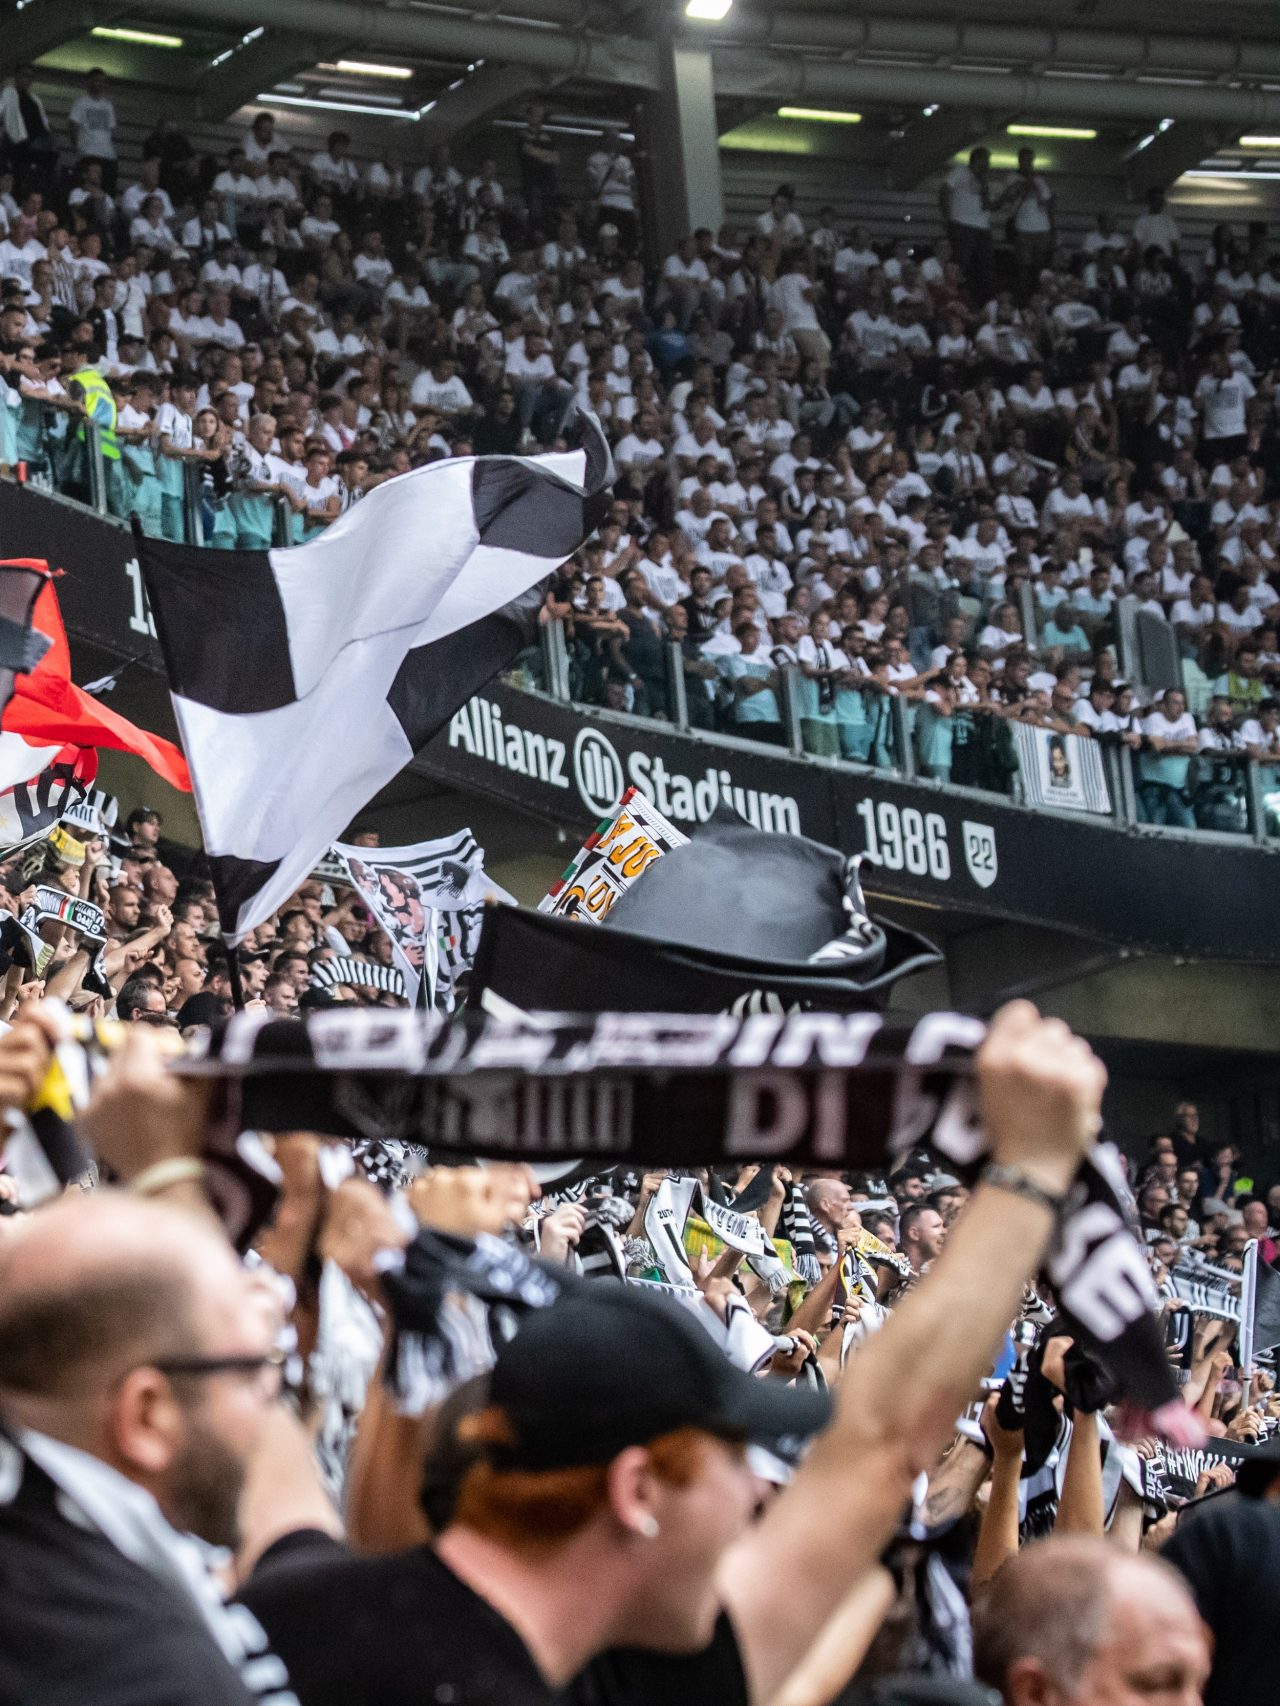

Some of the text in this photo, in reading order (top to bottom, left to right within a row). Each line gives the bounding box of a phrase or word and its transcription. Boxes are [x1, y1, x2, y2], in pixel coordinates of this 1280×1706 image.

[449, 696, 802, 838] Allianz Stadium
[66, 803, 96, 824] JUV
[607, 836, 660, 879] JU
[856, 797, 951, 881] 1986
[970, 835, 995, 870] 22
